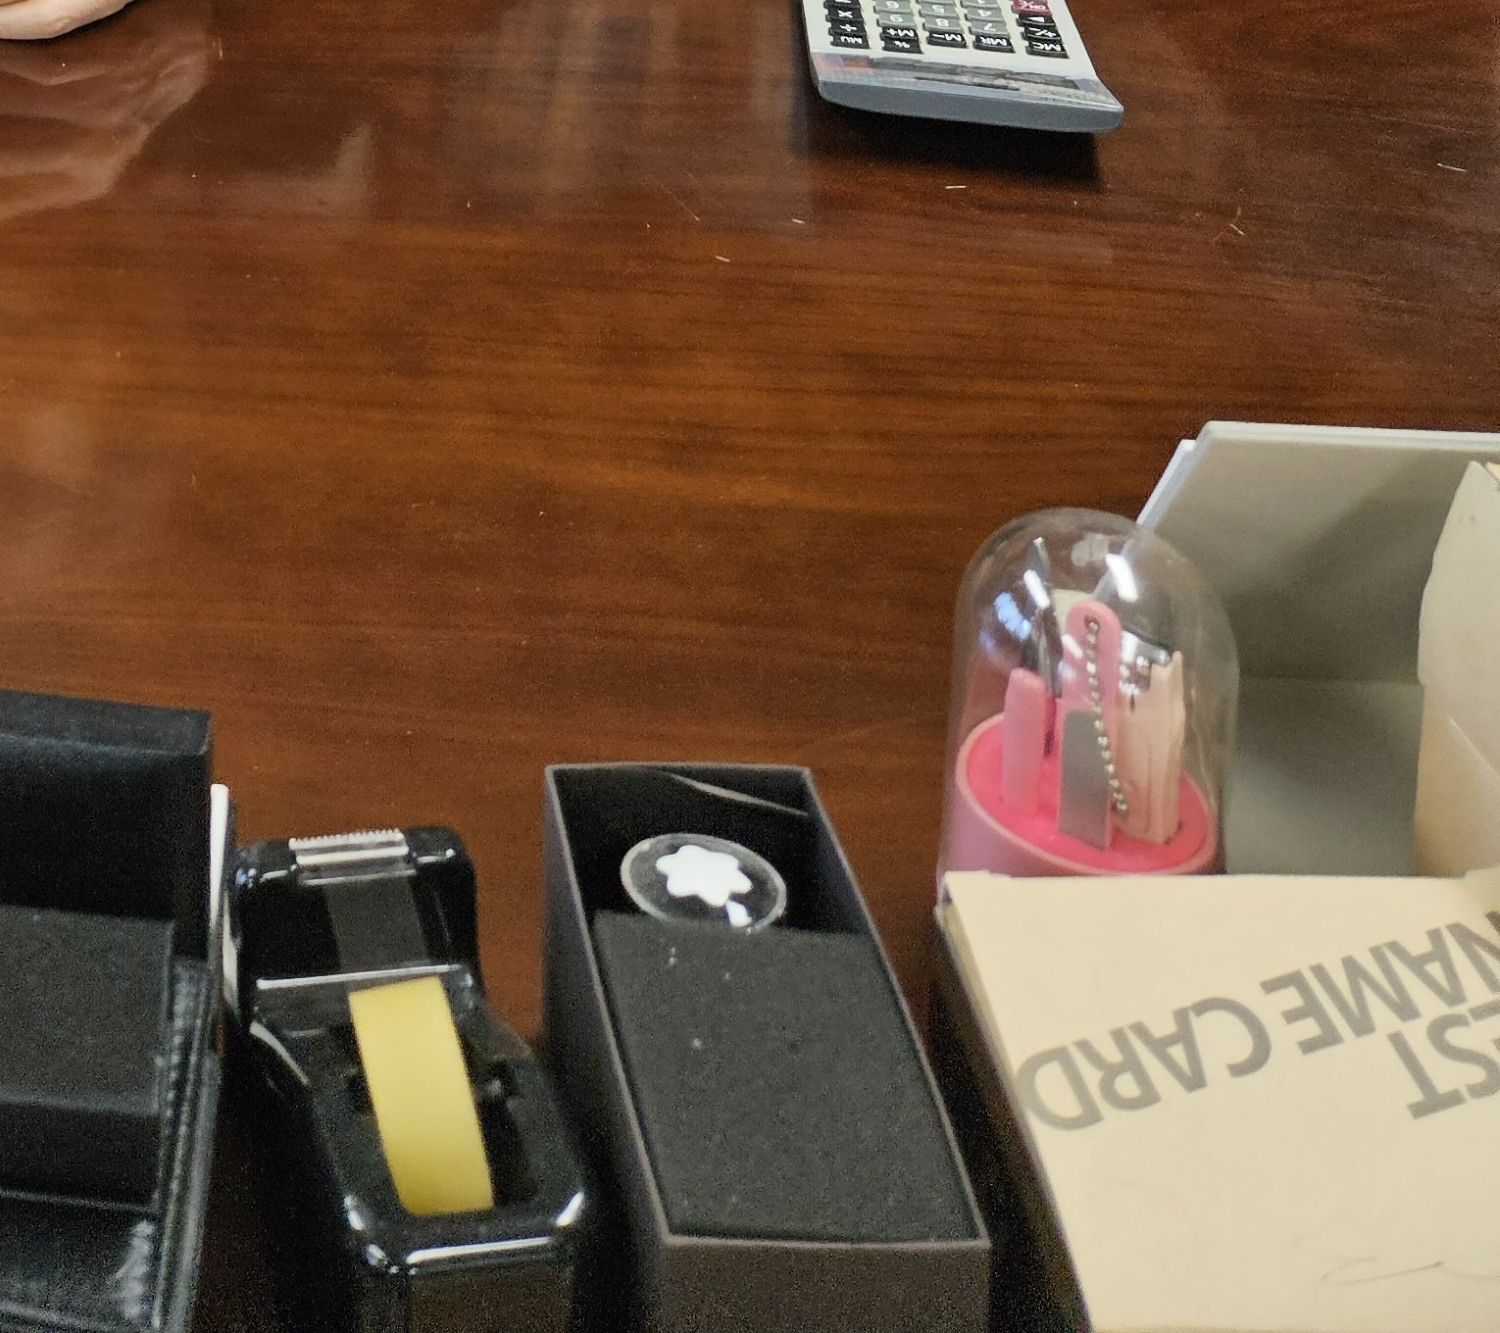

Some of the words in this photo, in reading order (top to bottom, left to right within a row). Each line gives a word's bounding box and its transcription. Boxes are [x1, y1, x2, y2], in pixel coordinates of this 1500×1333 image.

[888, 0, 900, 9] 6
[931, 4, 944, 13] 5
[978, 9, 992, 18] 4
[889, 14, 904, 23] 9
[935, 18, 950, 27] 8
[983, 22, 997, 32] 7
[886, 27, 914, 37] M+
[979, 36, 1008, 46] MR
[1032, 41, 1062, 52] MC
[1014, 996, 1273, 1131] CARD
